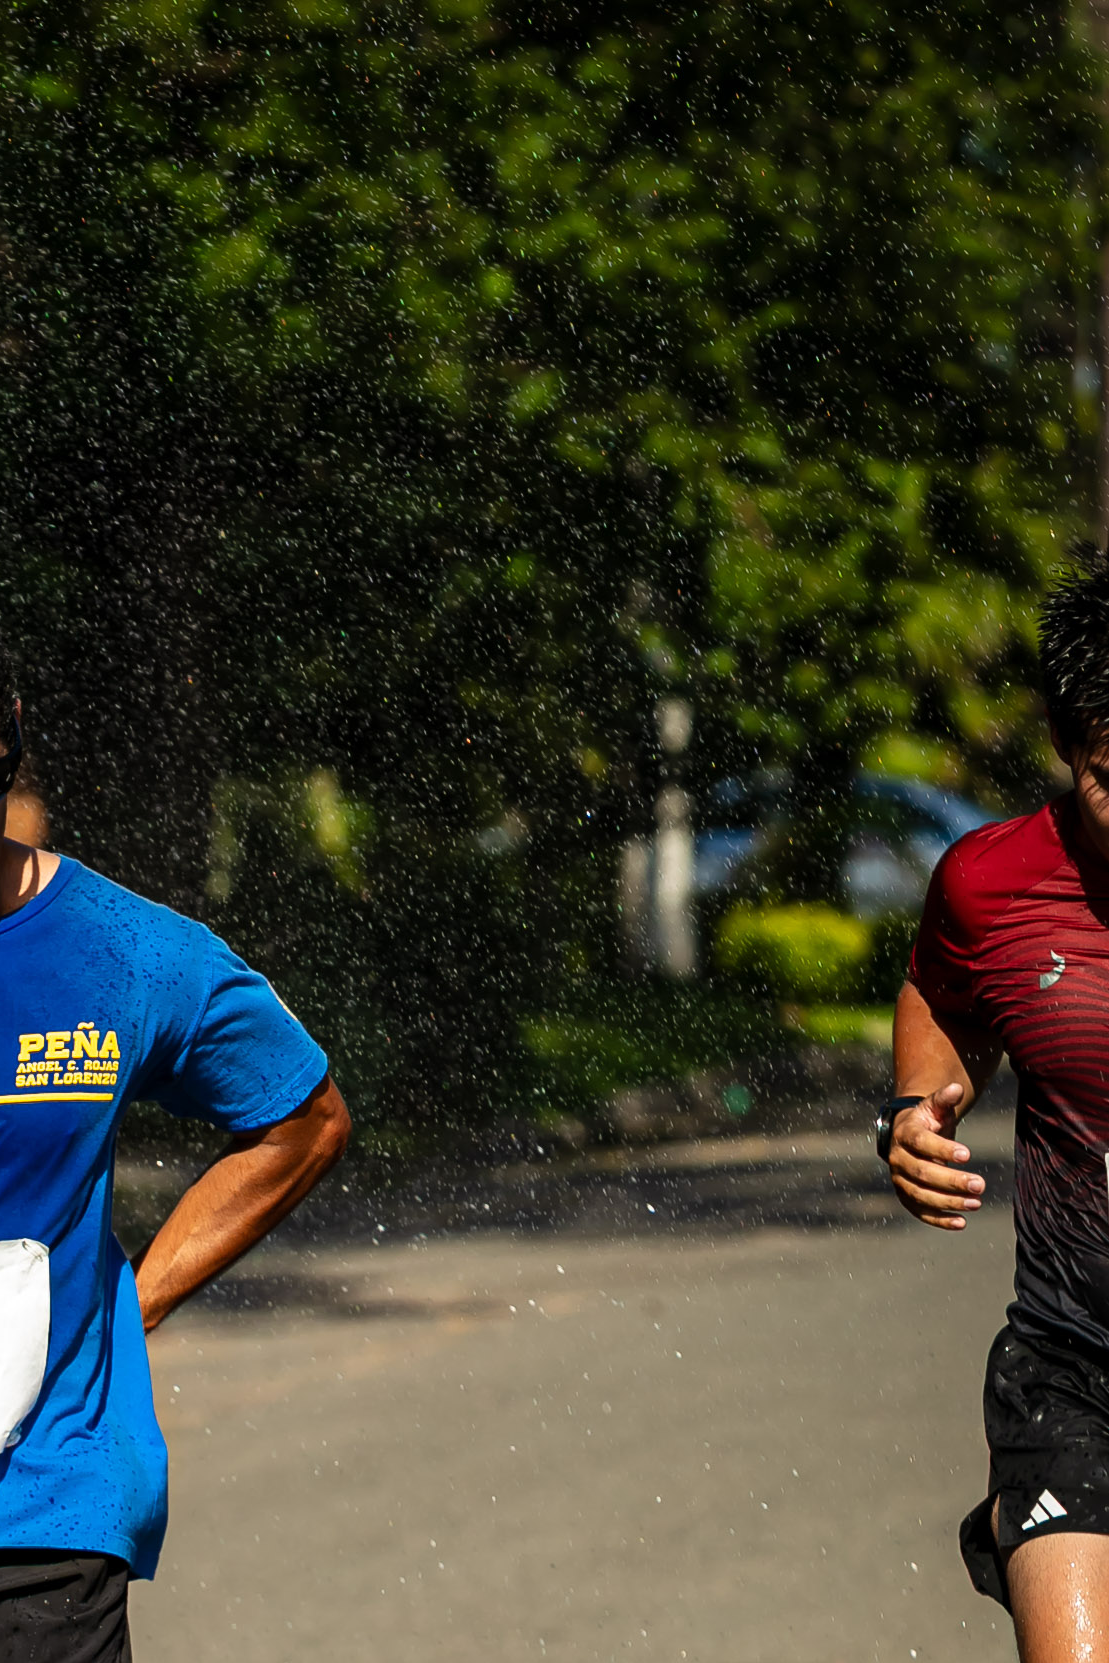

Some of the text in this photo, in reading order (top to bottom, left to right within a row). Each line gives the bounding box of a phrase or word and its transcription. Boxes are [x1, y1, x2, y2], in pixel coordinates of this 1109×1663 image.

[17, 1021, 121, 1062] PEÑA
[16, 1059, 119, 1074] ANGEL C. ROJAS
[15, 1071, 118, 1087] SAN LORENZO
